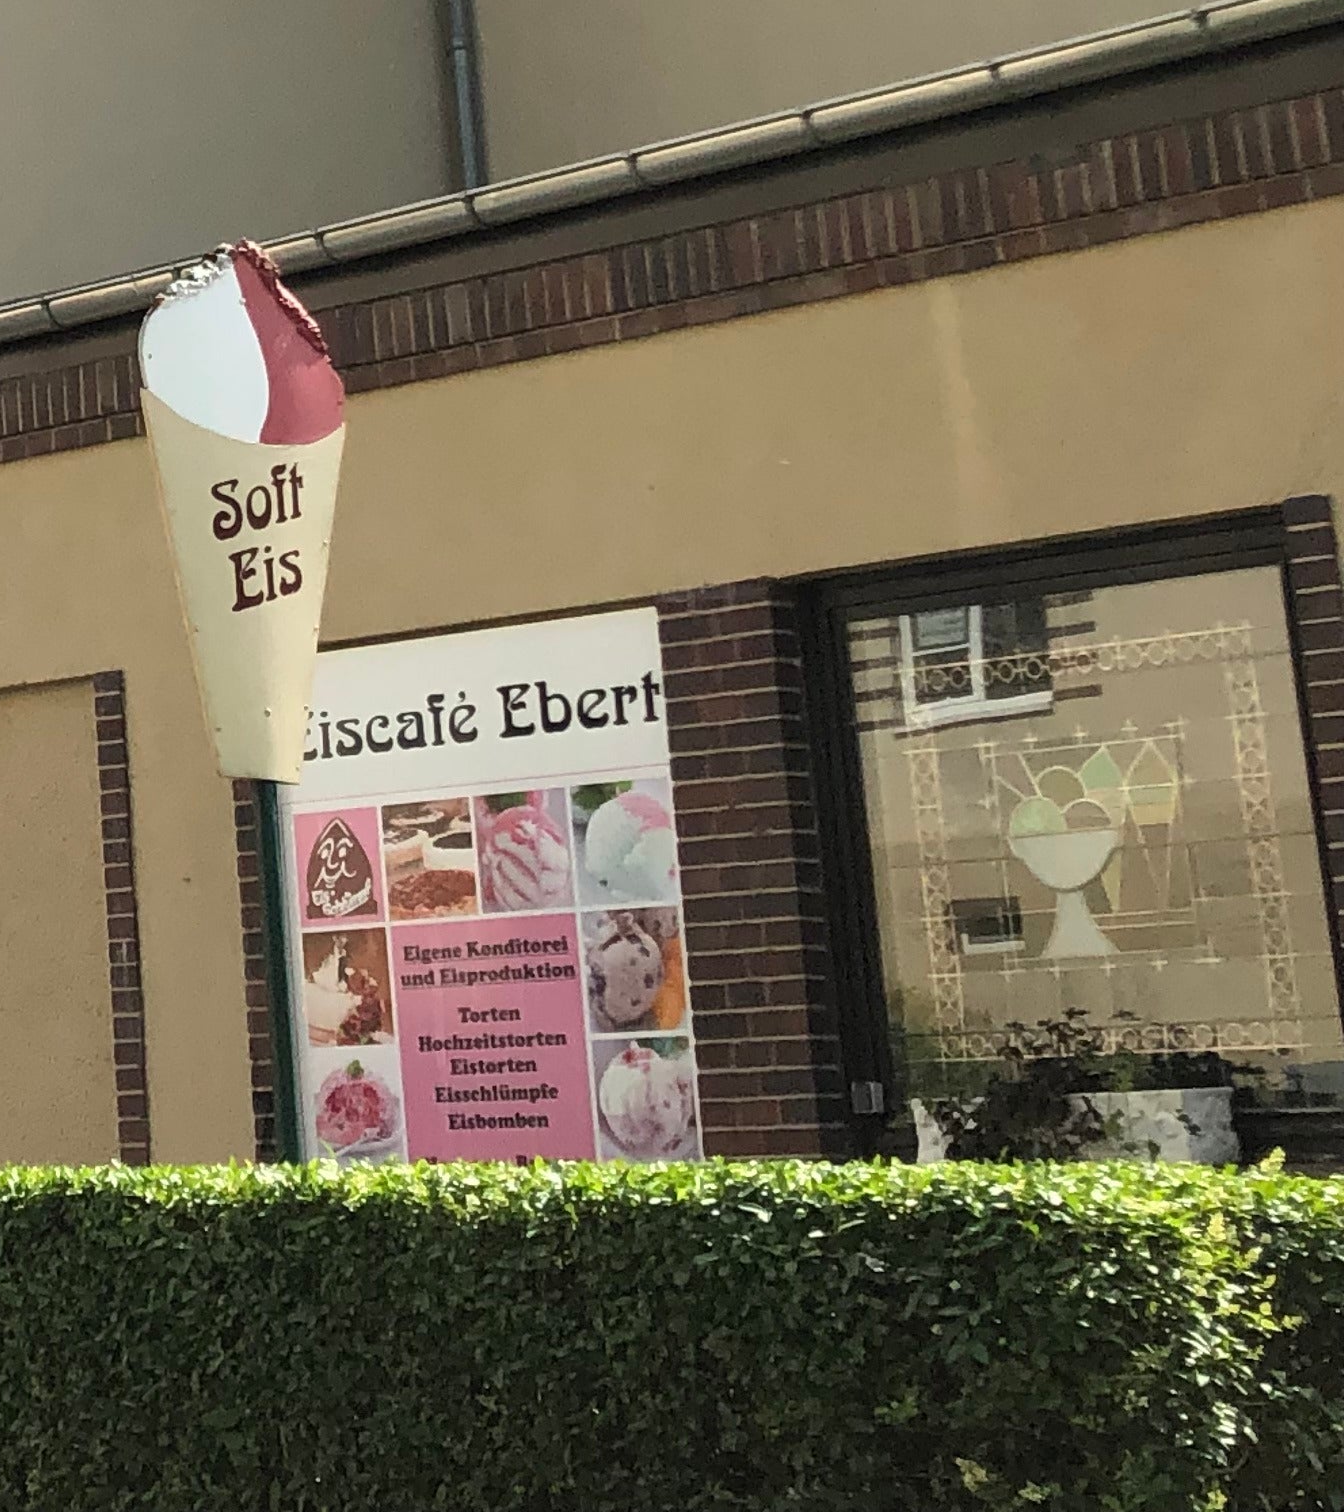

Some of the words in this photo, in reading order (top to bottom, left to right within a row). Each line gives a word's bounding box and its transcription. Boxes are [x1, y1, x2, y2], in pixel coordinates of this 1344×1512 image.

[210, 462, 305, 541] Soft
[228, 545, 303, 612] Eis
[496, 670, 661, 738] Ebert
[403, 944, 462, 964] Eigene
[466, 936, 569, 957] Konditorei
[400, 970, 435, 986] und
[440, 962, 576, 986] Eisproduktion
[457, 1007, 522, 1023] Torten
[418, 1031, 568, 1052] Hochzeitstorten
[450, 1058, 538, 1075] Eistorten
[435, 1083, 560, 1104] Eisschlümpfe
[448, 1112, 550, 1130] Eisbomben
